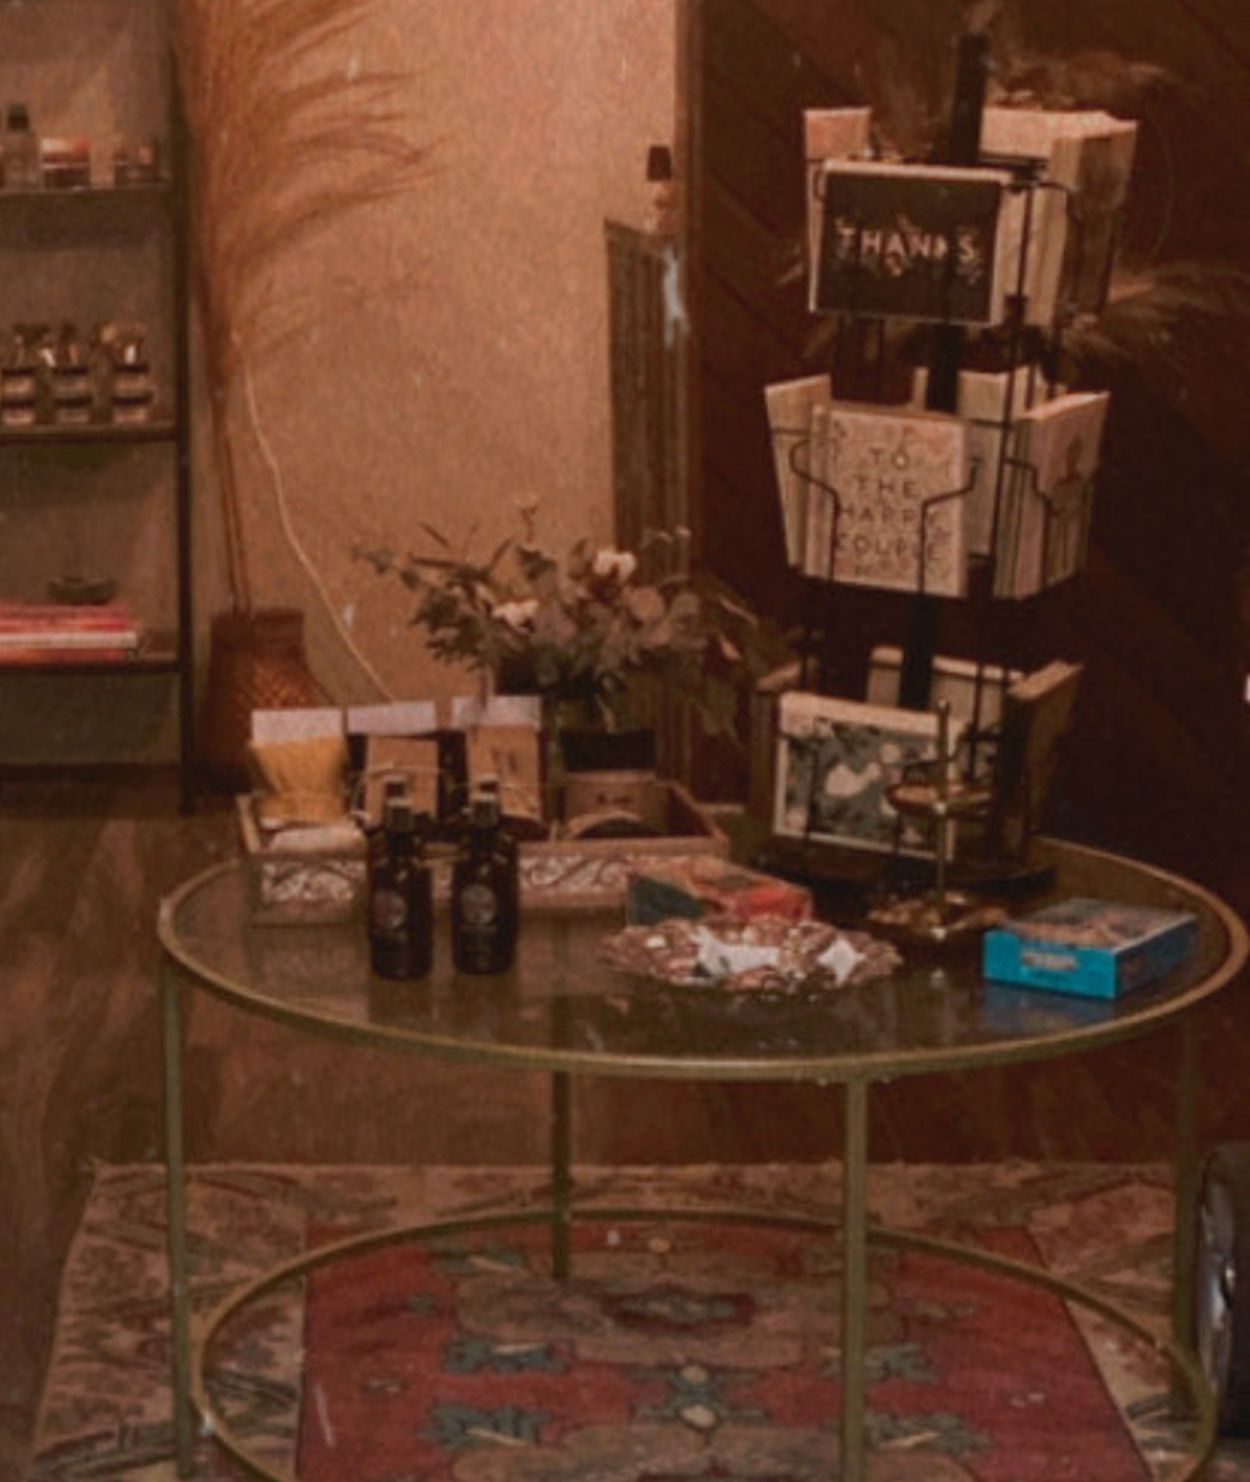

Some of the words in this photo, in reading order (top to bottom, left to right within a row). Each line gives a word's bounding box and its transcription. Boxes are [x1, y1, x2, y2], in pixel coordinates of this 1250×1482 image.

[836, 226, 974, 262] THANKS
[868, 447, 910, 471] TO
[853, 473, 918, 500] THE
